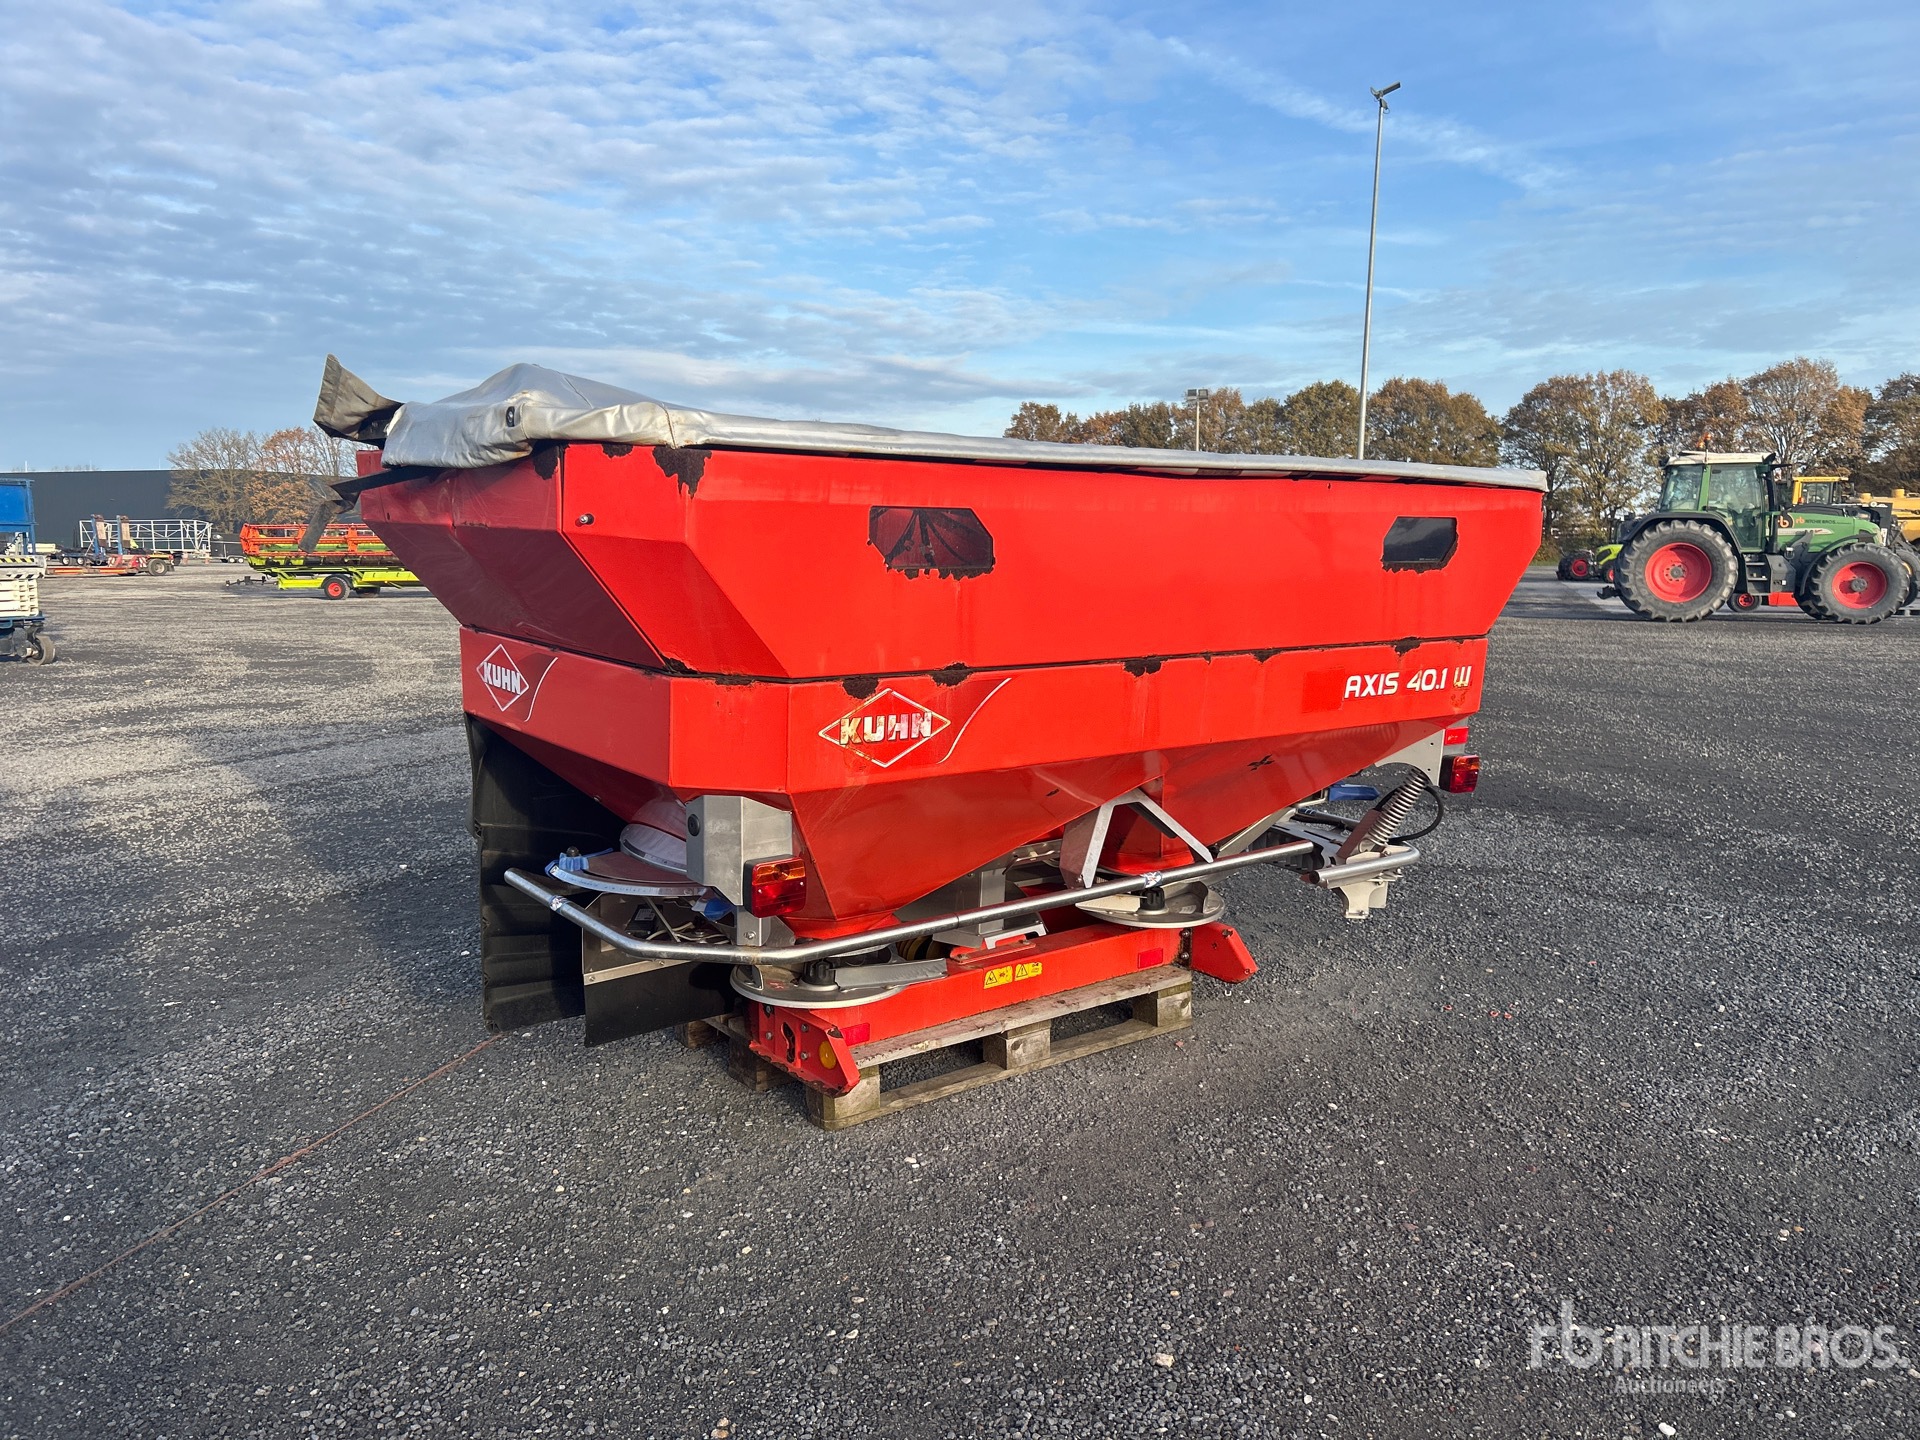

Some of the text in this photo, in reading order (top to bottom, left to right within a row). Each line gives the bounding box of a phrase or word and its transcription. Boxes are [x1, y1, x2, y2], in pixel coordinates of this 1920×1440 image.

[483, 661, 520, 695] KUHN
[1344, 672, 1400, 698] AXIS
[1406, 668, 1448, 691] 40.1
[839, 711, 934, 745] KUHN
